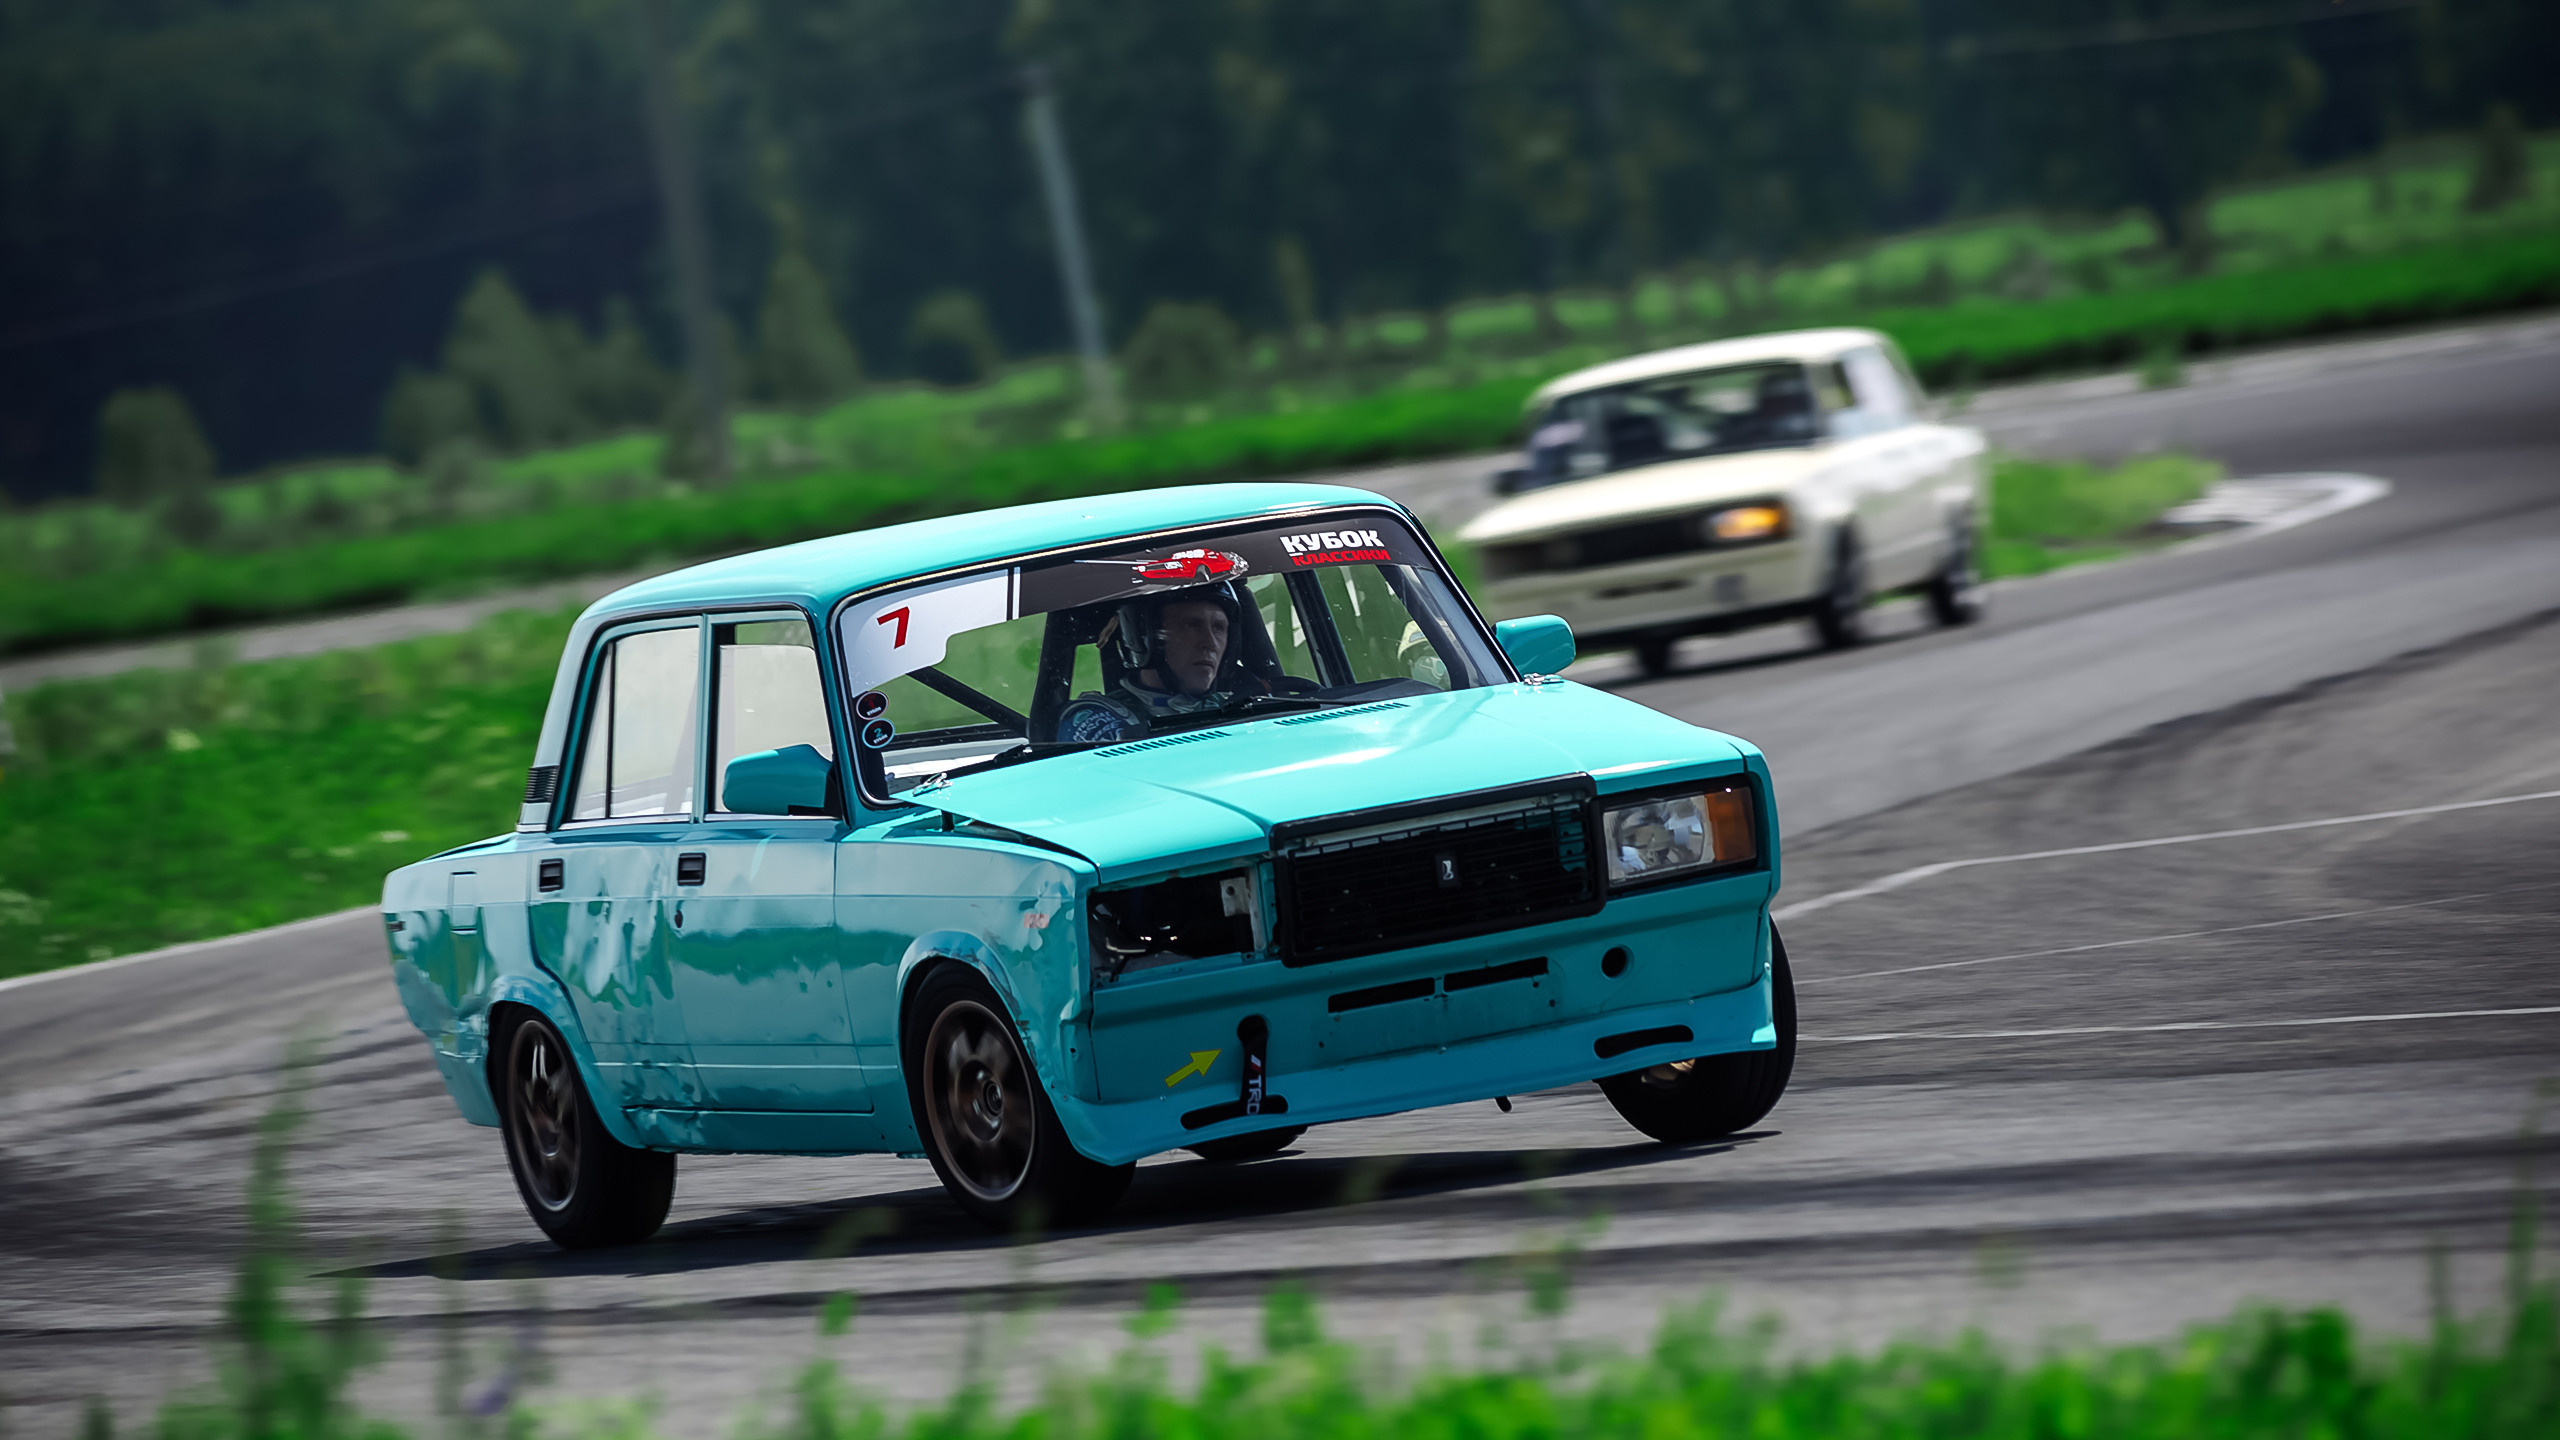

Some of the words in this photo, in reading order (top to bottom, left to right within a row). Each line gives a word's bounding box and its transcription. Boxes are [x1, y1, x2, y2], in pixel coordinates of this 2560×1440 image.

[1280, 530, 1385, 553] КУБОК
[1291, 549, 1391, 566] КЛАССИКИ
[877, 606, 910, 649] 7
[1247, 1074, 1262, 1115] TRD
